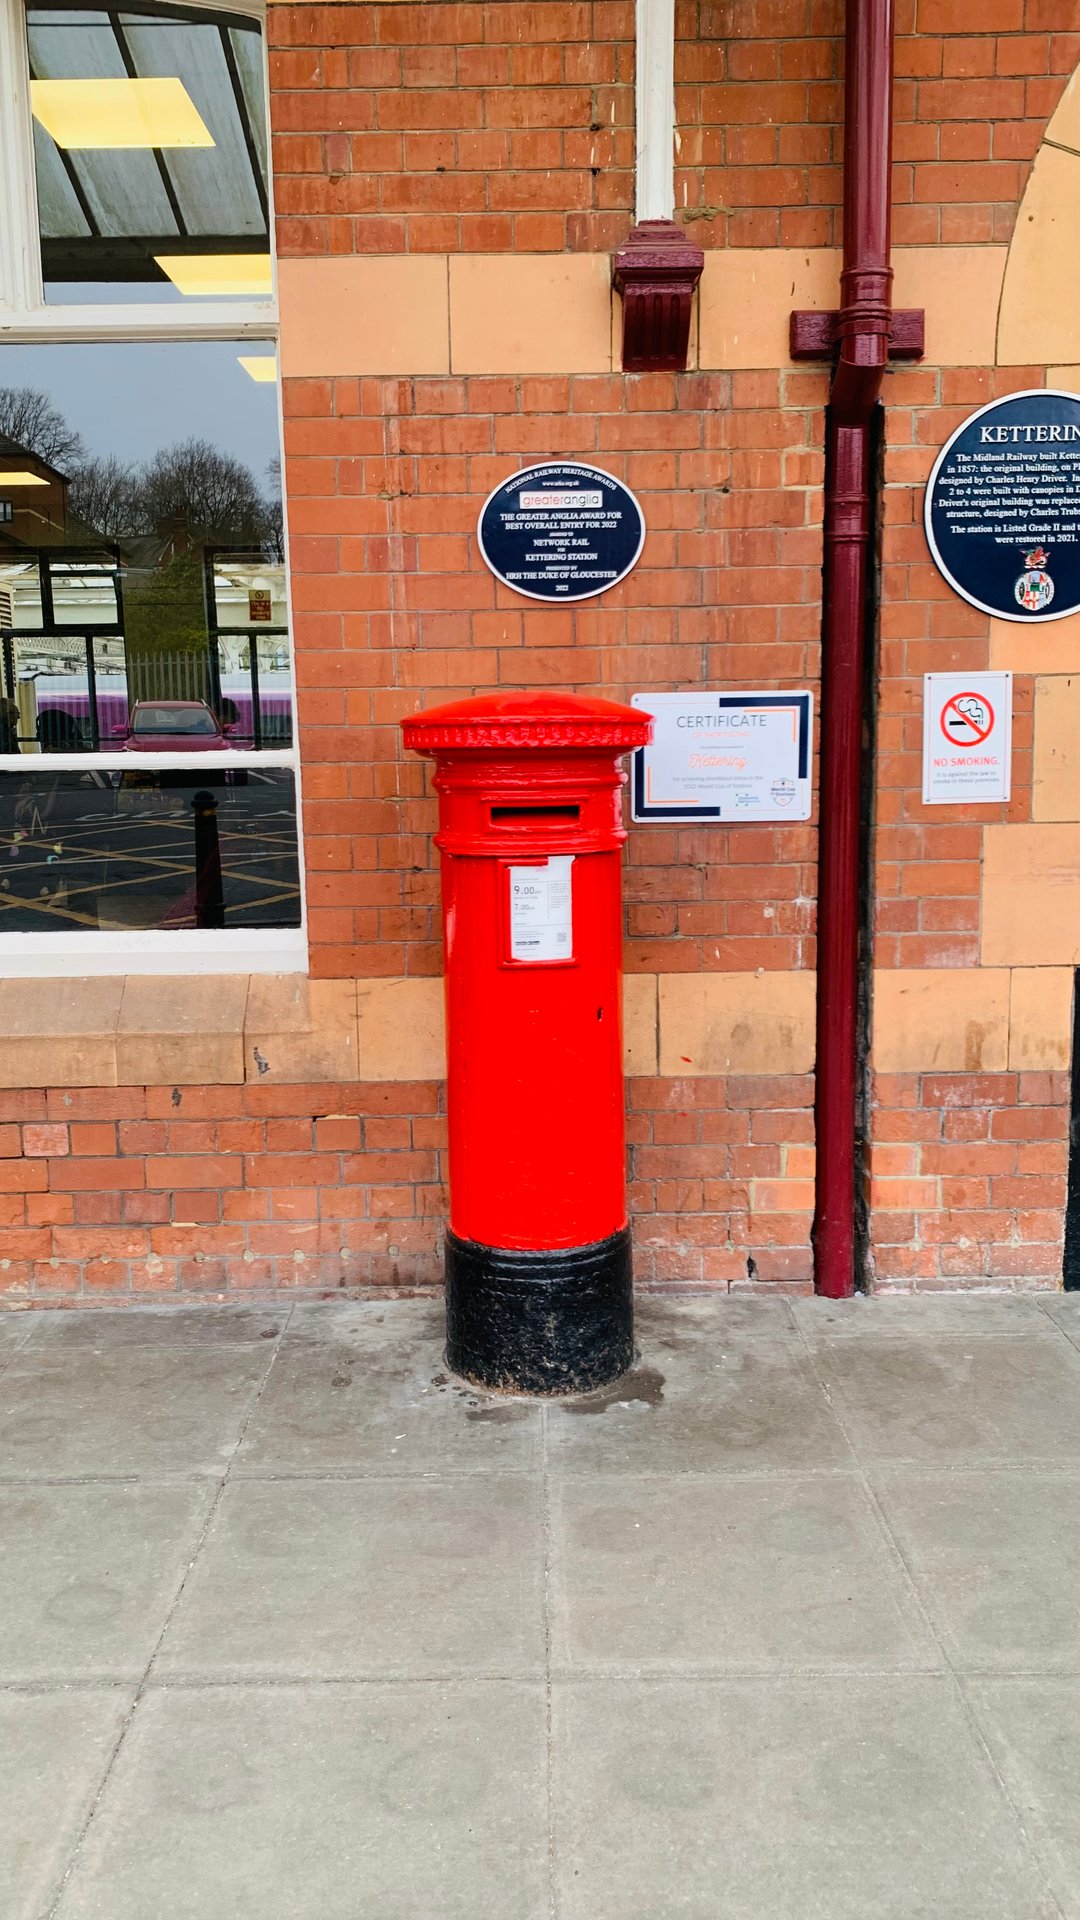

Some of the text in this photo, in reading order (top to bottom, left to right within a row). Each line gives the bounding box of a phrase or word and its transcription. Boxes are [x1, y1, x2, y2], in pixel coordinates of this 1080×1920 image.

[973, 453, 1005, 461] Midland
[1007, 453, 1038, 462] Railway
[1039, 452, 1057, 460] built
[947, 465, 956, 473] in
[994, 464, 1024, 473] original
[505, 468, 617, 493] NATIONAL RAILWAY HERITAGE AWARDS
[939, 477, 972, 486] designed
[974, 476, 984, 485] by
[986, 476, 1015, 484] Charles
[1016, 475, 1040, 484] Henry
[1041, 474, 1068, 482] Driver.
[949, 487, 955, 495] 2
[966, 487, 971, 495] 4
[993, 486, 1011, 494] built
[1012, 486, 1030, 494] with
[1031, 485, 1064, 495] canopies
[1066, 485, 1074, 493] in
[938, 499, 969, 507] Driver's
[971, 498, 1000, 507] original
[1002, 497, 1034, 506] building
[500, 511, 622, 521] THE GREATER ANGLIA AWARD FOR
[946, 510, 982, 518] structure,
[984, 508, 1017, 518] designed
[1019, 508, 1029, 518] by
[1030, 508, 1059, 516] Charles
[505, 521, 617, 530] BEST OVERALL ENTRY FOR 2022
[950, 525, 966, 533] The
[967, 525, 993, 533] station
[994, 524, 1002, 533] is
[1003, 524, 1027, 532] Listed
[1028, 523, 1051, 531] Grade
[1053, 523, 1060, 531] II
[1061, 522, 1075, 531] and
[533, 538, 590, 547] NETWORK RAIL
[1015, 534, 1046, 543] restored
[1047, 534, 1056, 543] in
[1057, 534, 1078, 542] 2021.
[525, 552, 598, 561] KETTERING STATION
[506, 572, 522, 580] HRH
[560, 571, 570, 579] OF
[571, 570, 618, 579] GLOUCESTER
[676, 714, 768, 728] CERTIFICATE
[933, 758, 948, 767] NO
